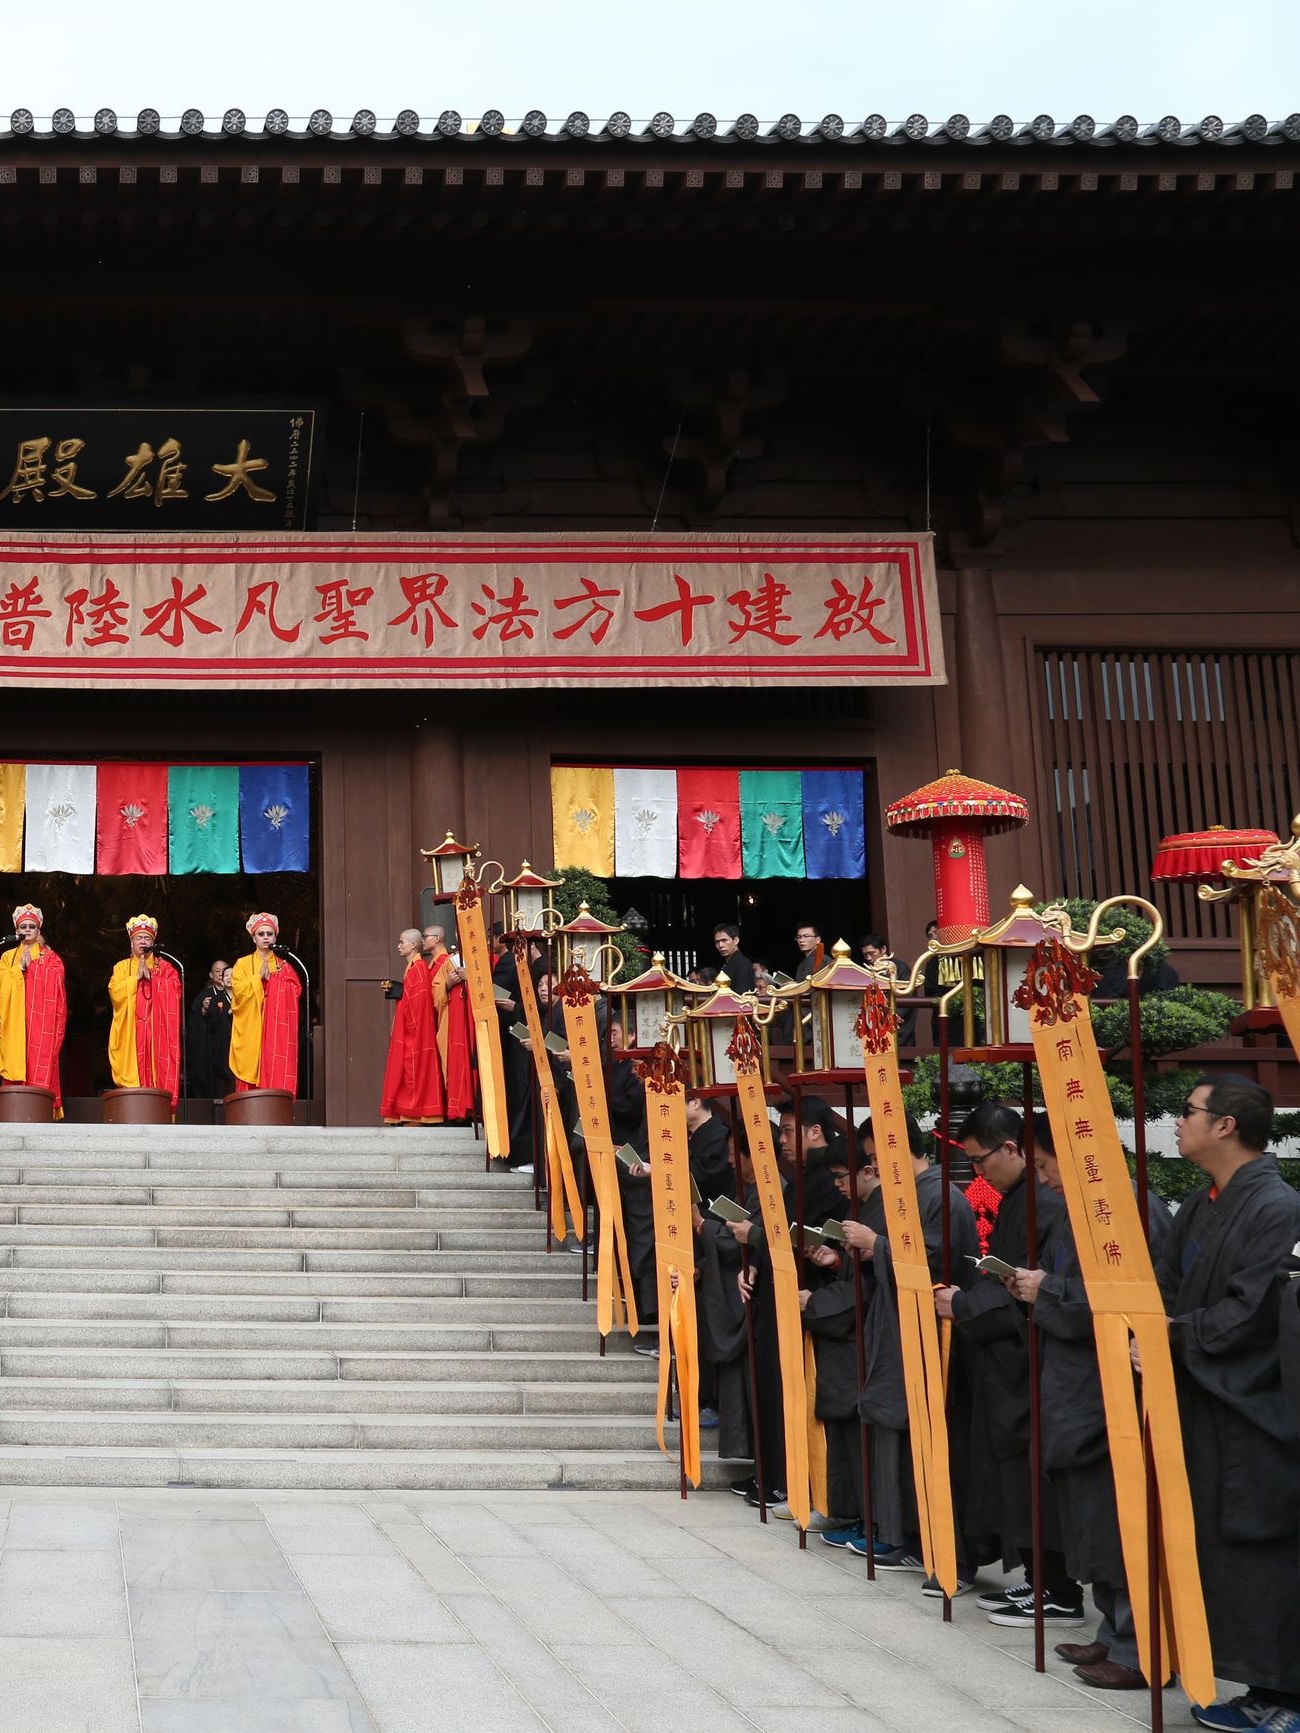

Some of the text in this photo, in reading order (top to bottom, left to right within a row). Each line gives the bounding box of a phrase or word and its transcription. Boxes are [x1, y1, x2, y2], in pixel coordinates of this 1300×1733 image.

[659, 1103, 678, 1240] 南無無量壽佛
[1056, 1036, 1122, 1267] 南無無量壽佛
